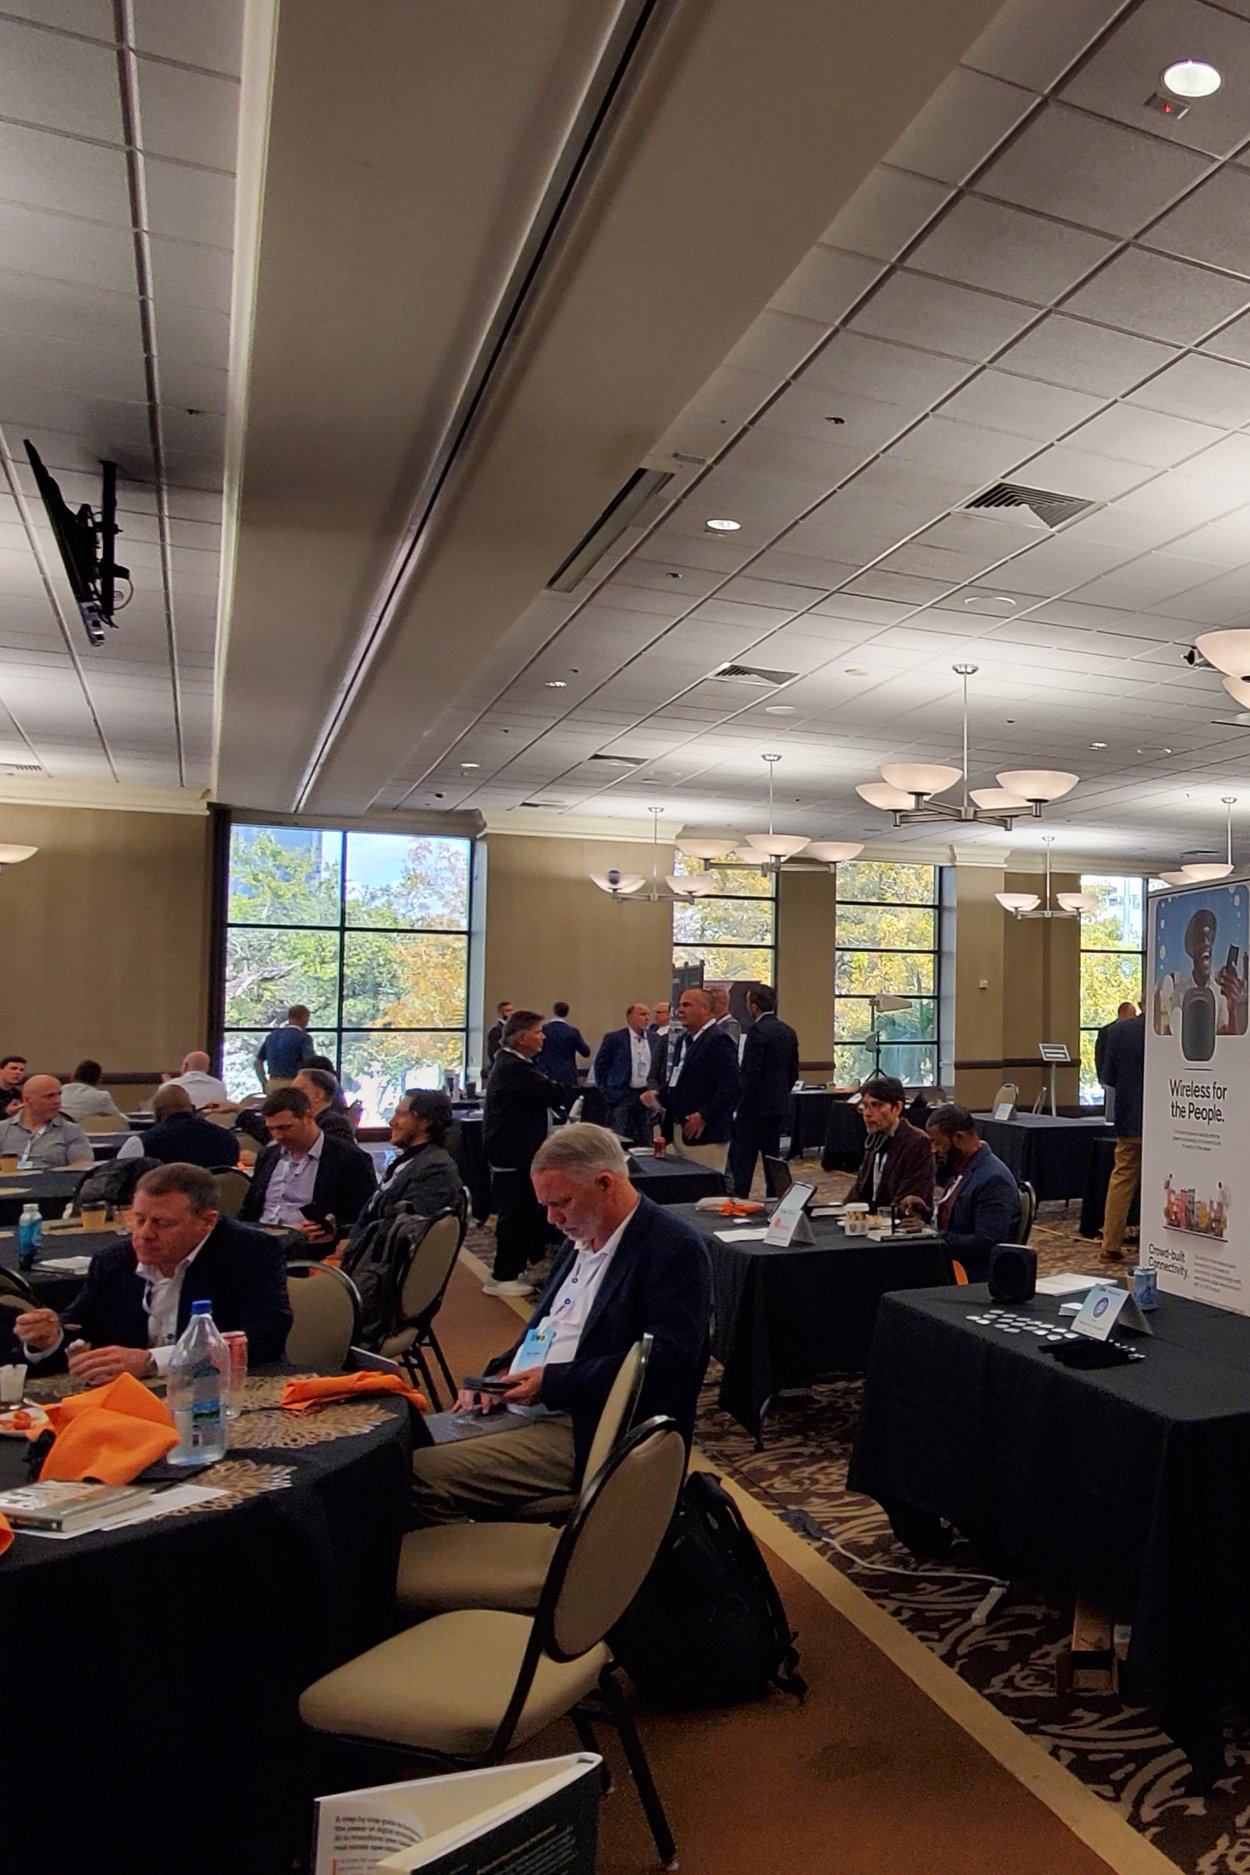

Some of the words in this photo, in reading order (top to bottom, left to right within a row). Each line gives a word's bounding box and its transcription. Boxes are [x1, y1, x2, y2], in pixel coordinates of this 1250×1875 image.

[1170, 1079, 1210, 1099] Wireless
[1212, 1081, 1227, 1100] for
[1171, 1101, 1186, 1118] the
[1188, 1102, 1224, 1125] People.
[1149, 1243, 1185, 1263] Crowd-built
